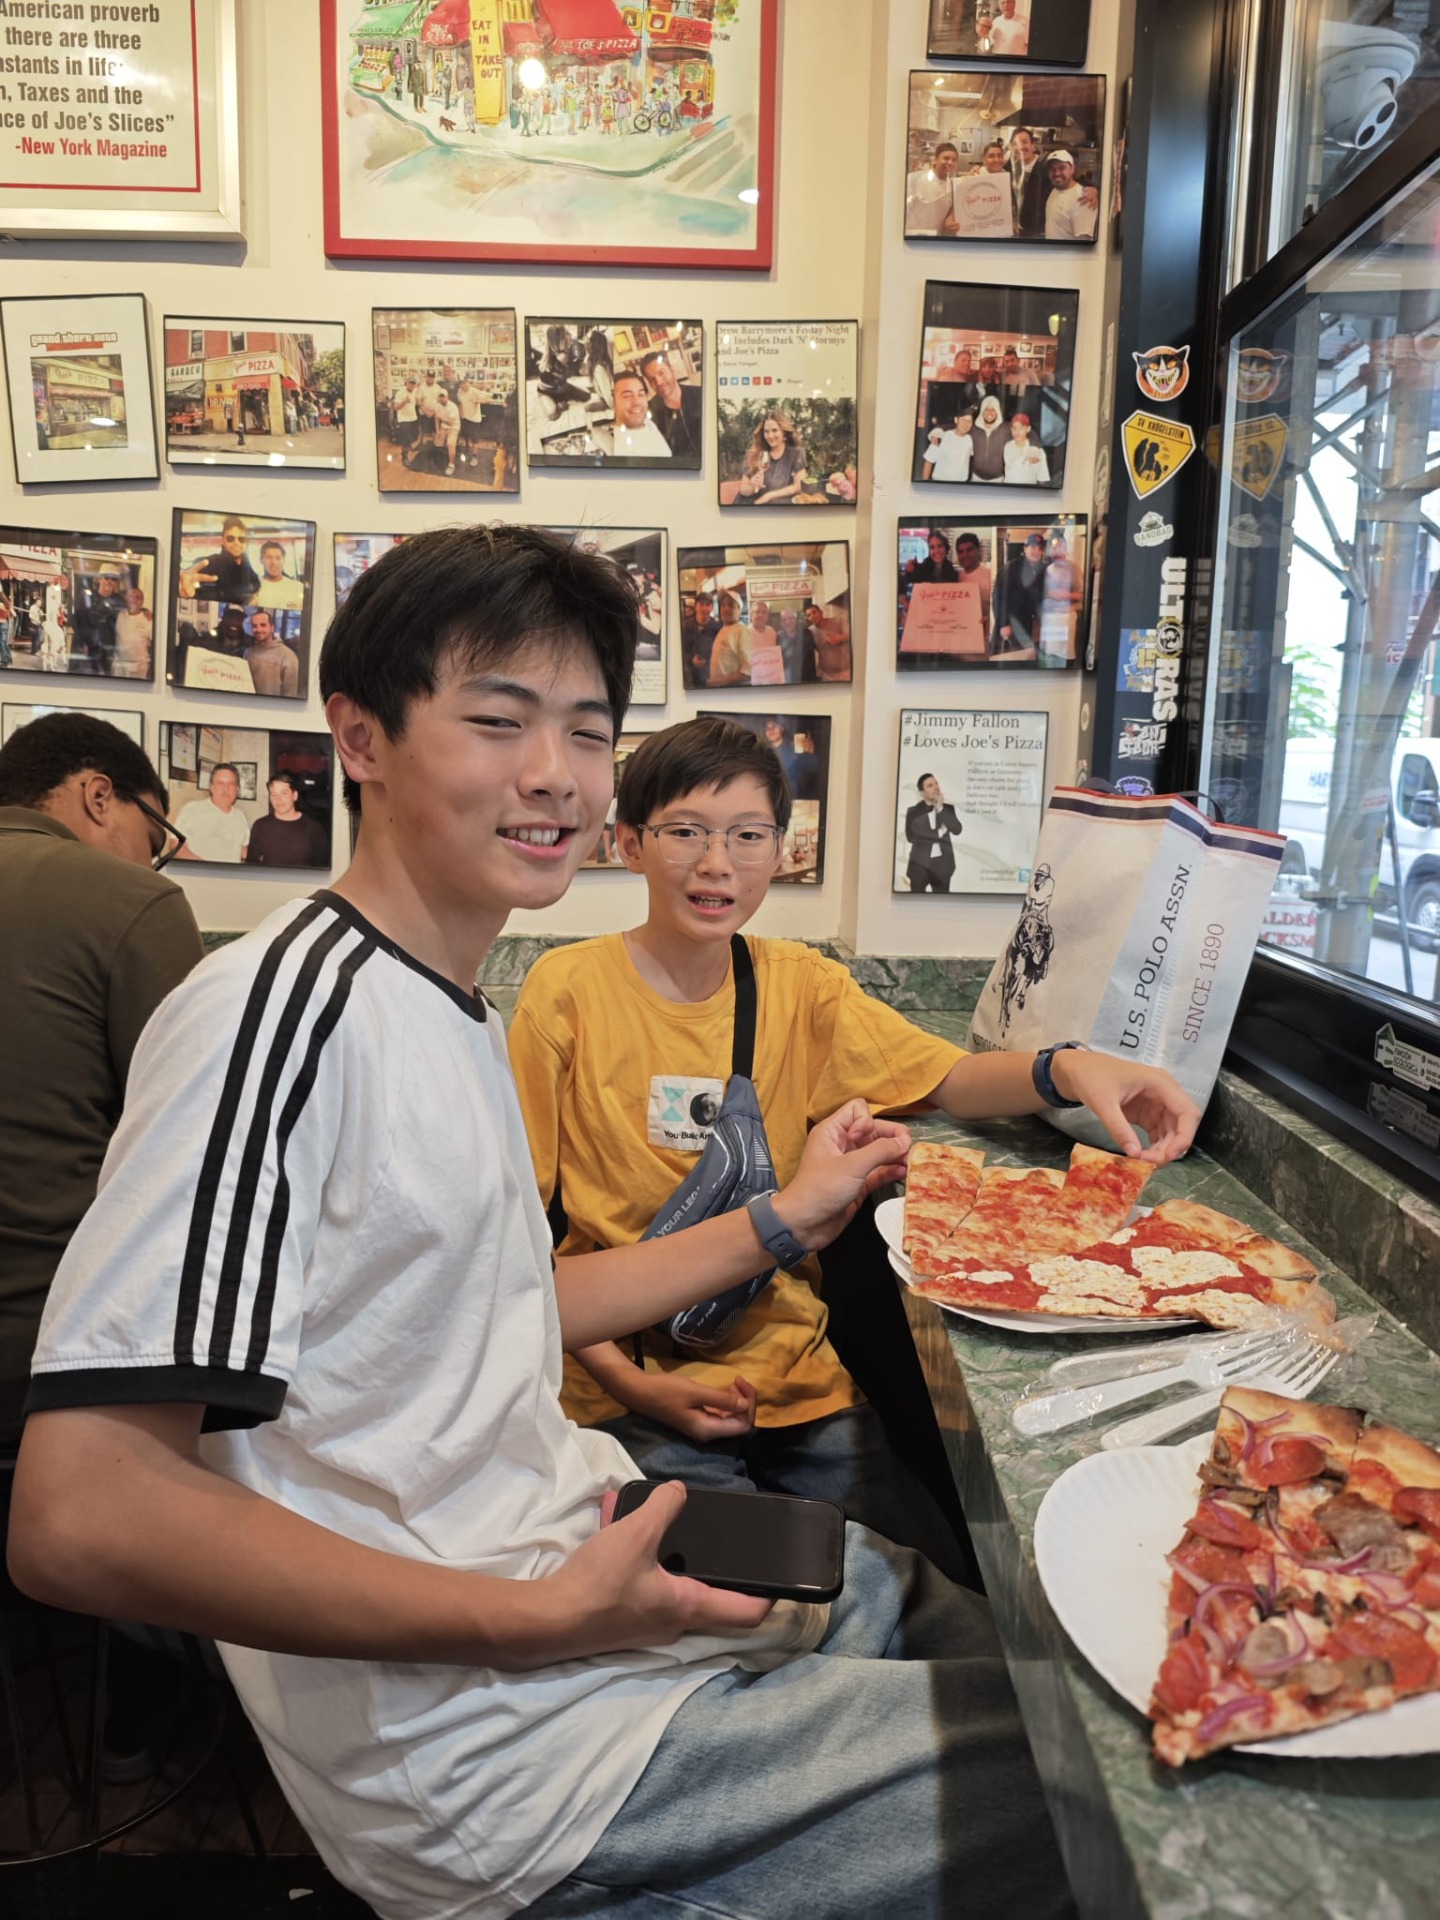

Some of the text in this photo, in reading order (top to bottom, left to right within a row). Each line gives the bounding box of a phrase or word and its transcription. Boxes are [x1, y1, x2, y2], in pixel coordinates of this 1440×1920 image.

[90, 4, 160, 22] proverb
[472, 20, 492, 30] EAT
[5, 26, 141, 50] there are three
[478, 35, 489, 44] IN
[605, 38, 638, 49] PIZZA
[475, 54, 502, 65] TAKE
[65, 56, 82, 75] in
[480, 68, 501, 78] OUT
[17, 82, 69, 102] Taxes
[76, 85, 108, 104] and
[114, 86, 142, 105] the
[31, 111, 48, 129] of
[54, 111, 102, 131] Joe's
[60, 138, 92, 156] York
[97, 139, 167, 161] Magazine
[825, 325, 849, 336] Night
[734, 336, 770, 345] Includes
[772, 336, 794, 345] Dark
[734, 346, 755, 355] Joe's
[757, 346, 780, 355] Pizza
[248, 360, 275, 371] PIZZA
[1137, 417, 1146, 428] SV
[772, 580, 810, 591] PIZZA
[941, 590, 971, 599] PIZZA
[904, 712, 1021, 731] #Jimmy Fallon
[903, 734, 1044, 750] #Loves Joe's Pizza
[1119, 864, 1192, 1049] U.S. POLO ASSN.
[1182, 923, 1225, 1043] SINCE 1890
[664, 1130, 679, 1139] You
[657, 1210, 684, 1236] YOUR
